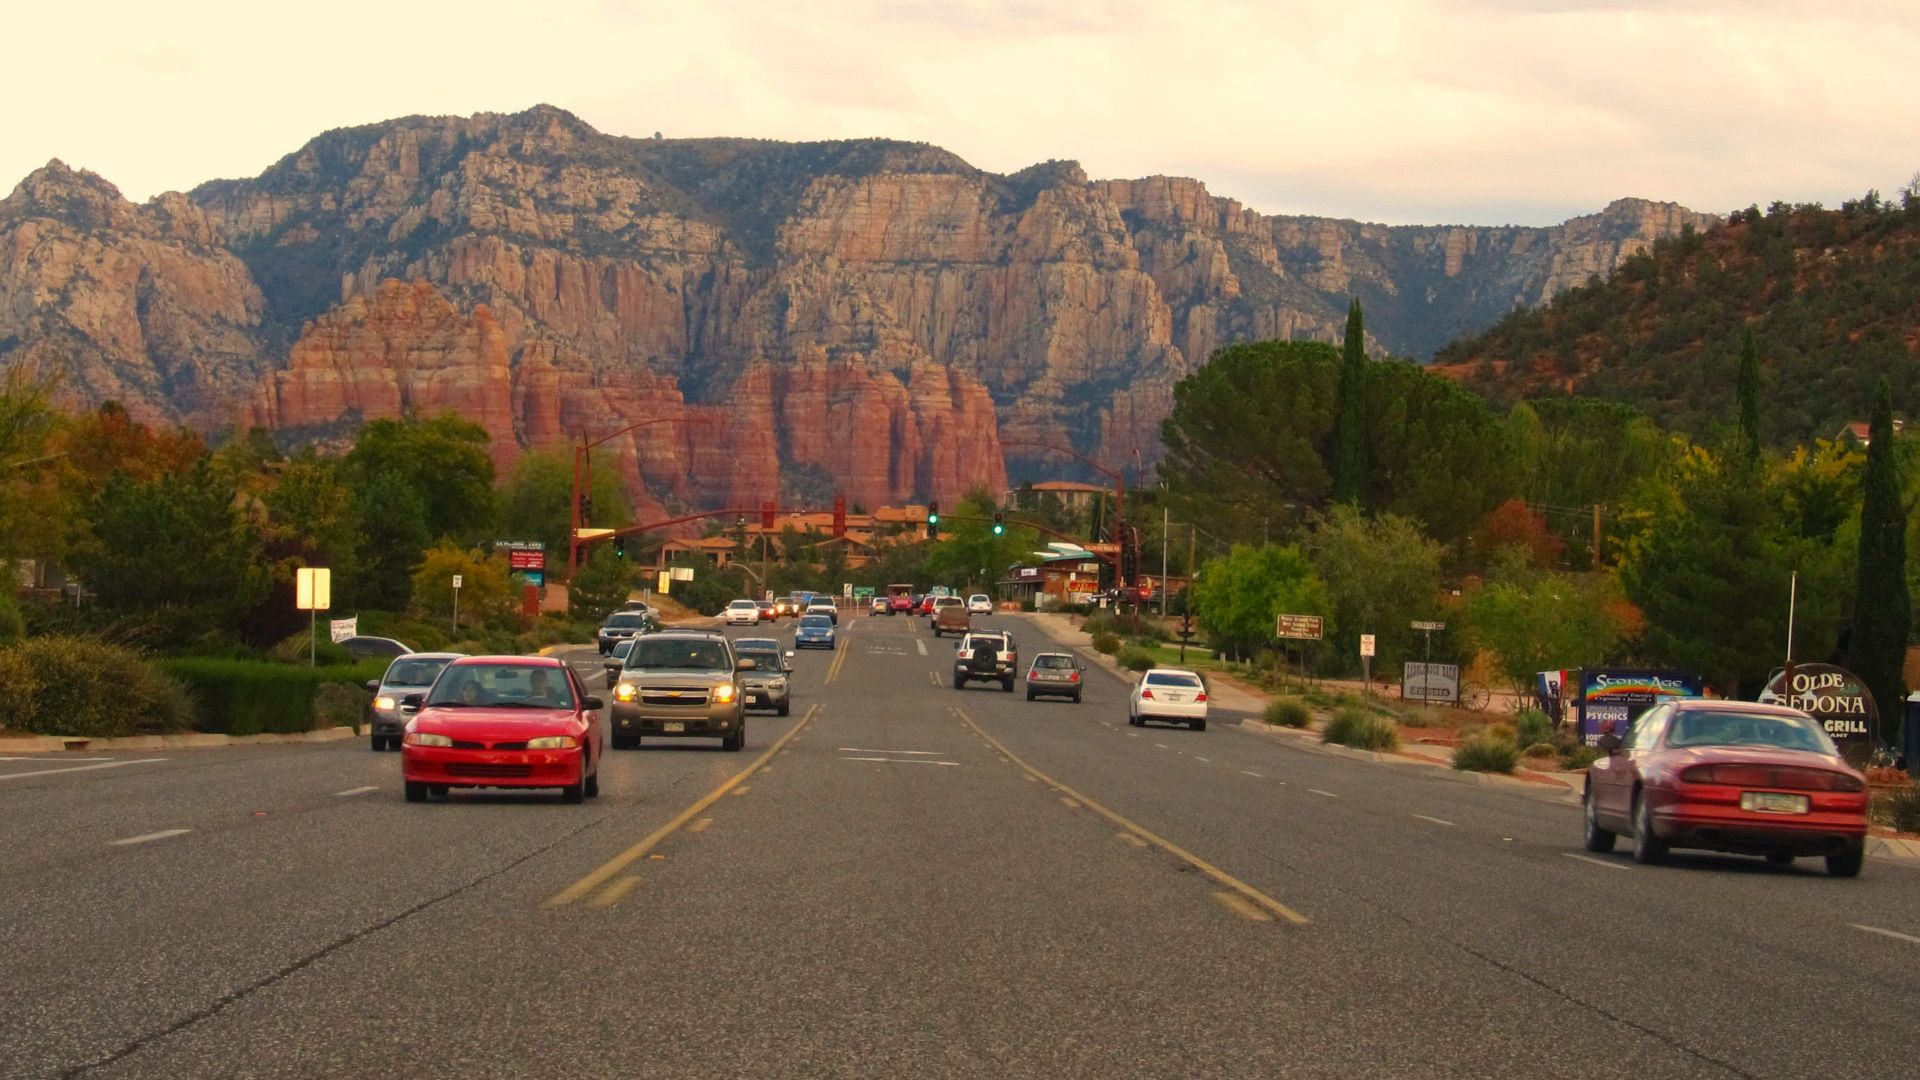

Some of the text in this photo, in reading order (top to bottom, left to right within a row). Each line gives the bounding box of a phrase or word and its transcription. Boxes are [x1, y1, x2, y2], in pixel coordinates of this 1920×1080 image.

[1792, 673, 1844, 692] OLDE
[1773, 694, 1866, 714] SEDONA
[1585, 711, 1628, 720] PSYCHICS
[1824, 719, 1867, 733] GRILL
